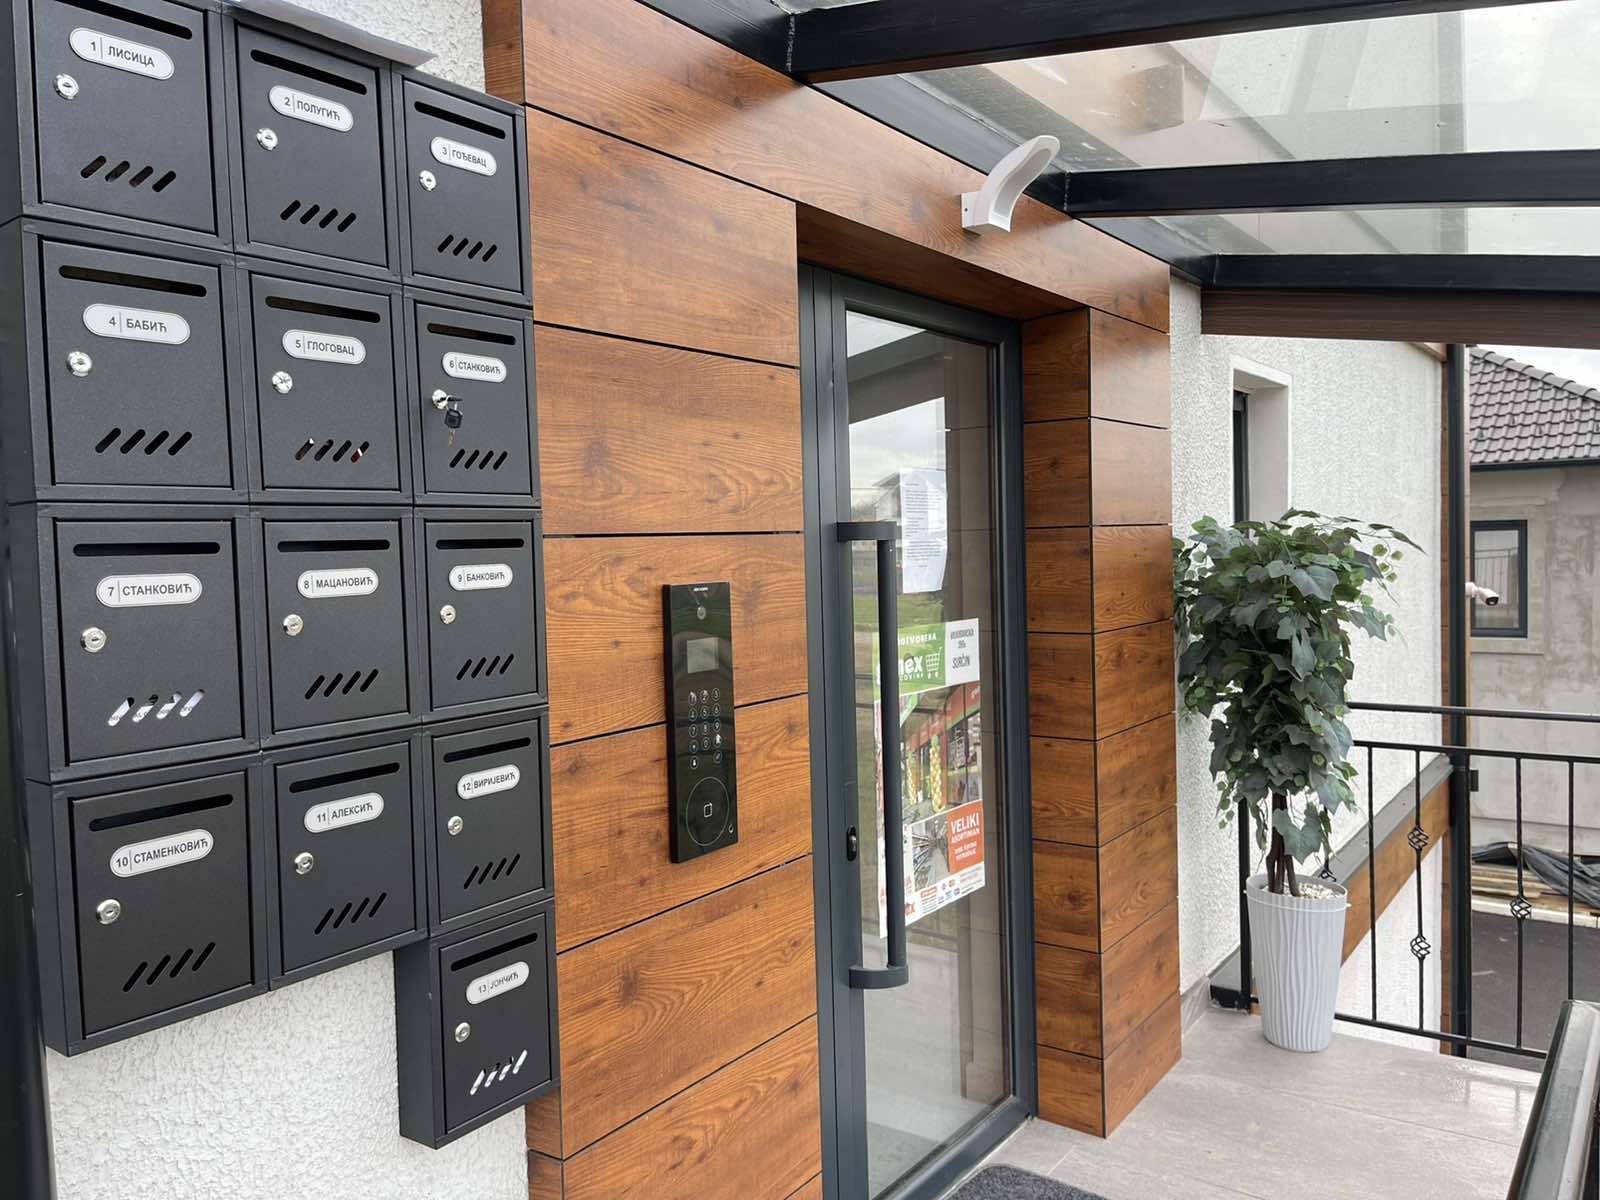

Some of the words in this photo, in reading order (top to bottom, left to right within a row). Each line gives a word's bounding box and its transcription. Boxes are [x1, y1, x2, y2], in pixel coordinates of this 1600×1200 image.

[90, 41, 96, 51] 1
[108, 46, 155, 68] ЛИСИЦА
[284, 96, 290, 107] 2
[442, 147, 448, 155] 3
[109, 316, 116, 326] 4
[126, 318, 167, 332] БАБИЋ
[295, 339, 301, 348] 5
[307, 340, 355, 356] ГЛОГОВАЦ
[449, 360, 454, 368] 6
[458, 361, 500, 374] СТАНКОВИЋ
[303, 580, 309, 589] 8
[316, 577, 373, 588] МАЦАНОВИЋ
[457, 574, 462, 582] 9
[466, 572, 505, 582] БАНКОВИЋ
[108, 587, 114, 597] 7
[122, 583, 192, 596] СТАНКОВИЋ
[463, 782, 470, 791] 12
[317, 813, 326, 822] 11
[331, 803, 373, 820] АЛЕКСИЋ
[951, 812, 980, 834] VELIKI
[115, 857, 128, 868] 10
[133, 838, 208, 863] СТАМЕНКОВИЋ
[479, 984, 486, 993] 13
